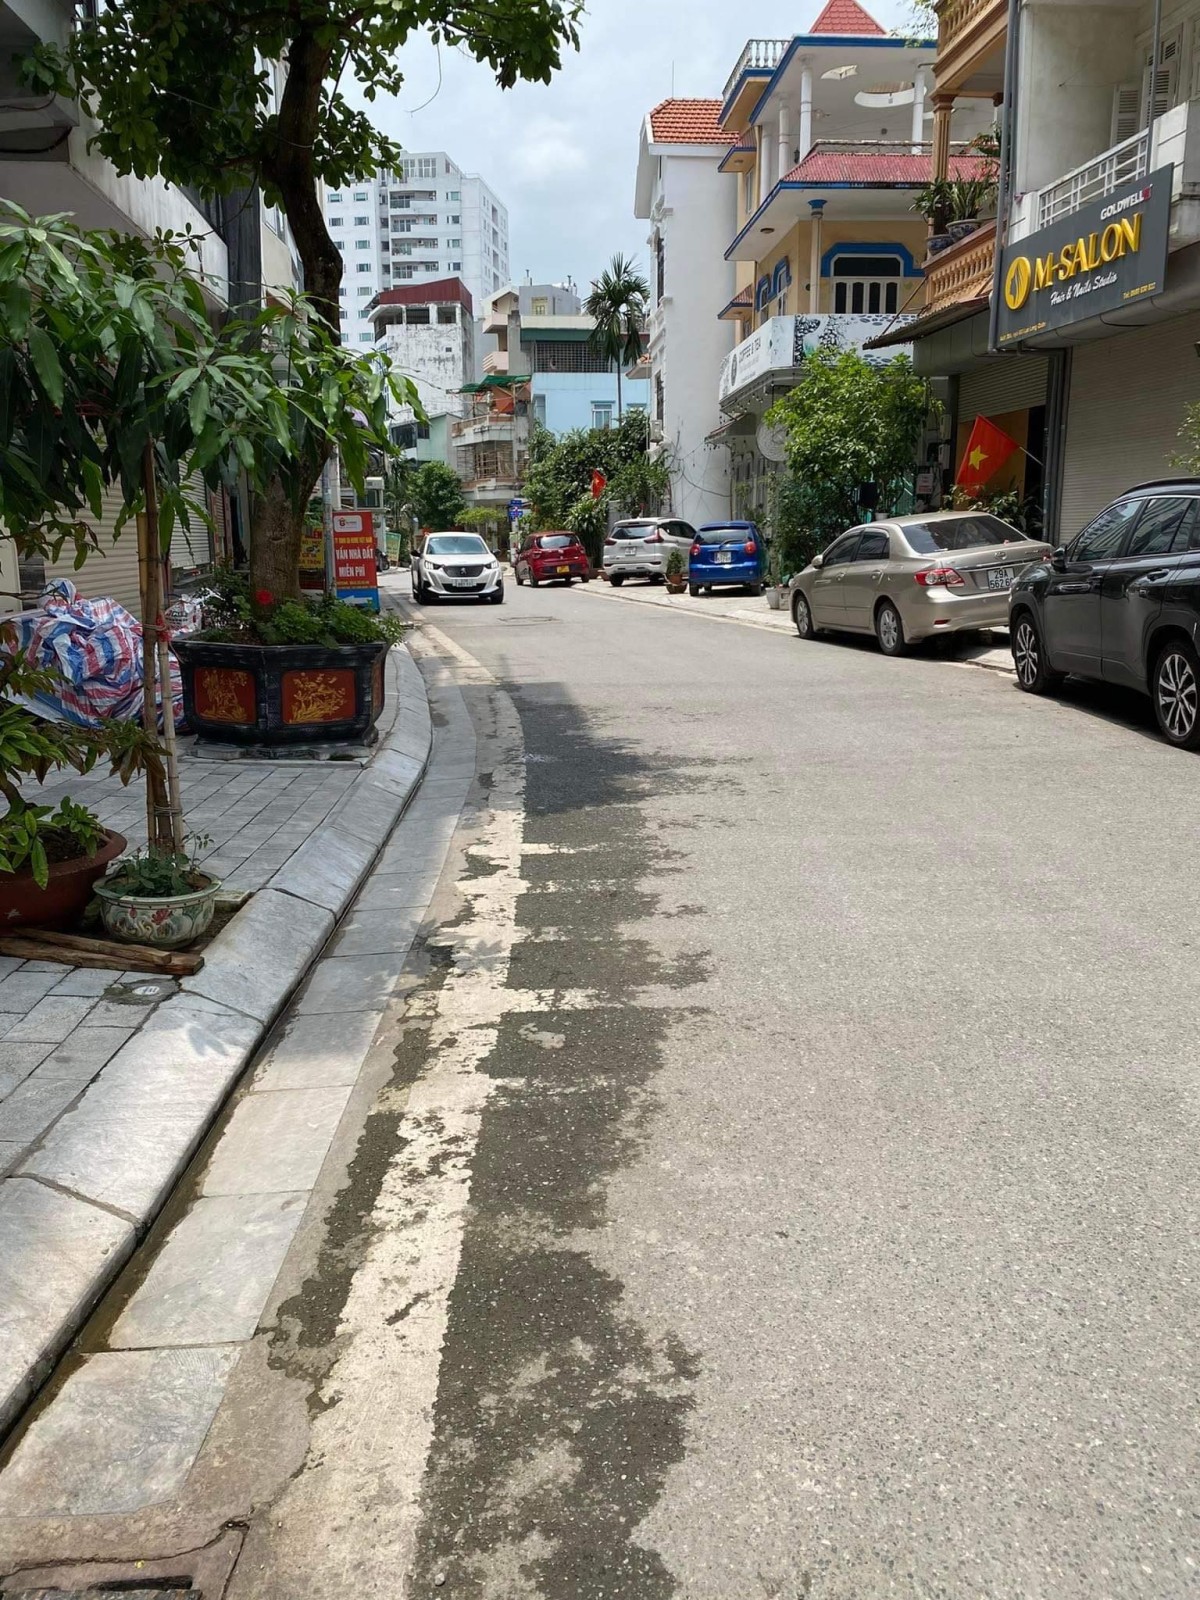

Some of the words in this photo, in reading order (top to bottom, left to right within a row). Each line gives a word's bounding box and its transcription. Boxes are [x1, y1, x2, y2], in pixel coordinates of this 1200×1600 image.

[1101, 193, 1144, 220] GOLDWELL
[1033, 212, 1143, 292] M-SALON
[1050, 291, 1066, 306] Hair
[1092, 271, 1118, 290] Studio
[349, 546, 362, 559] NHÀ
[994, 569, 1008, 579] 29A
